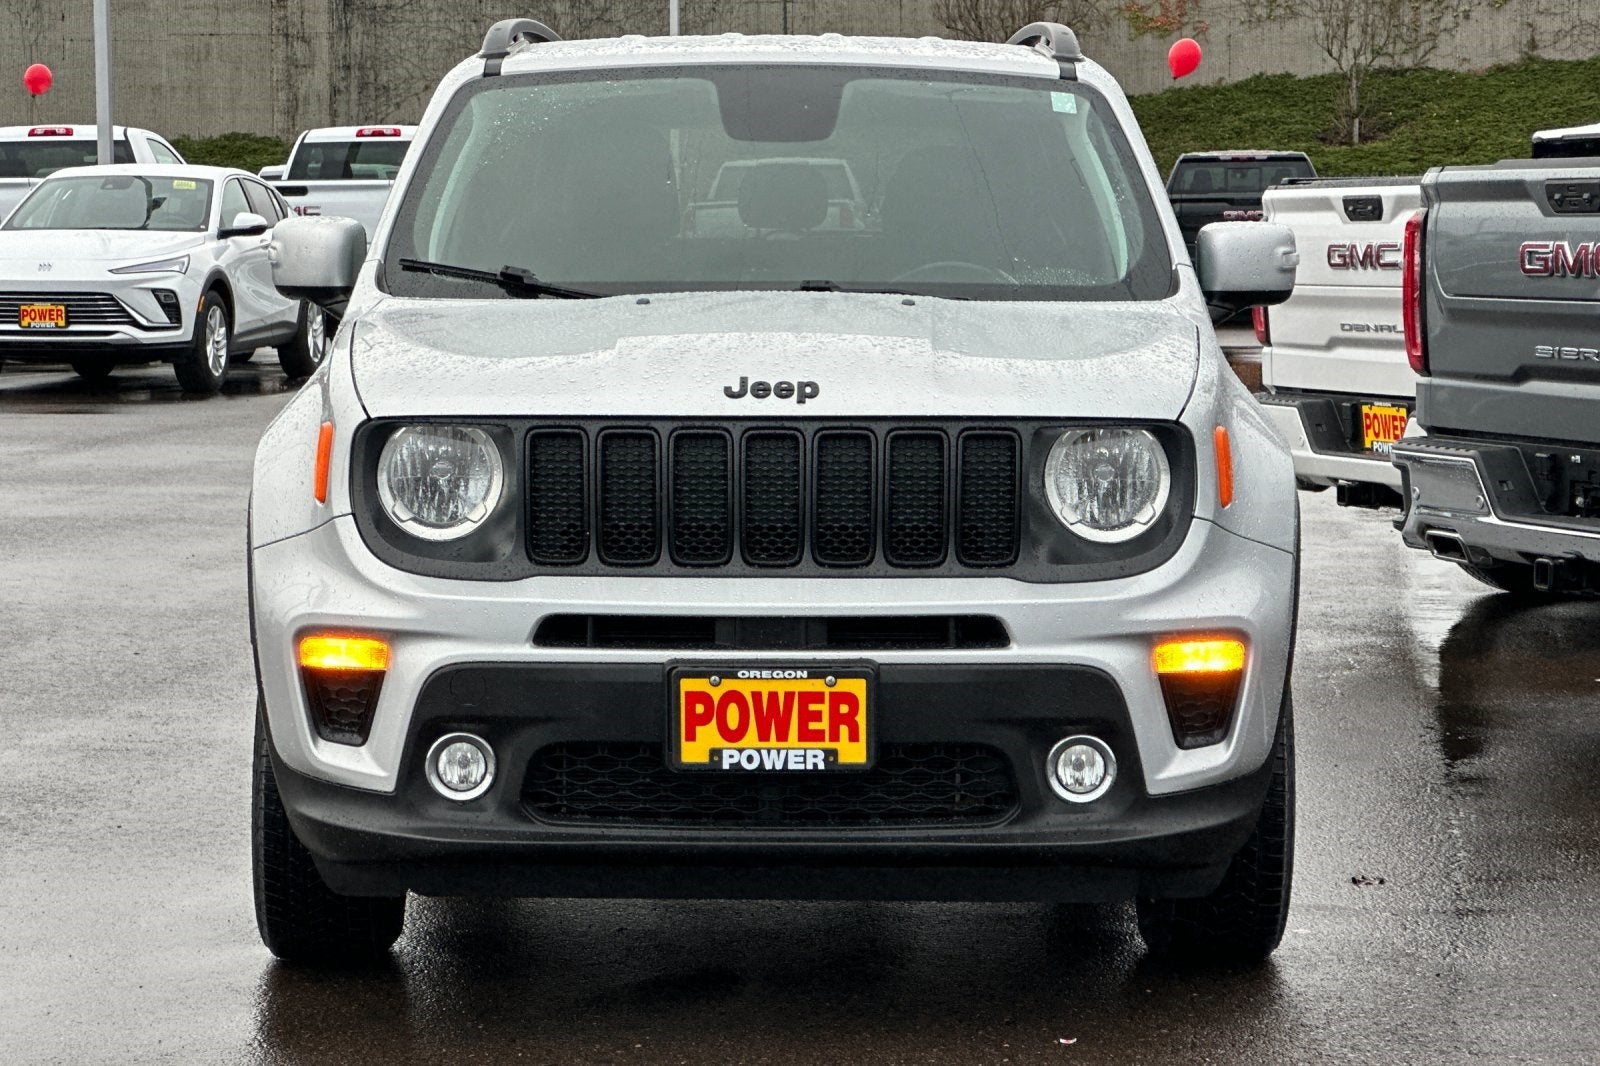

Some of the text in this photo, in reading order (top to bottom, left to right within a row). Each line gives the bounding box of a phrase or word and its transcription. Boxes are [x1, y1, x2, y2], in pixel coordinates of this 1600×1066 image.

[1327, 243, 1402, 271] GMC
[1519, 240, 1600, 279] GM
[21, 308, 64, 322] POWER
[723, 376, 820, 405] Jeep
[737, 670, 808, 679] OREGON
[684, 689, 860, 744] POWER
[722, 749, 825, 770] POWER
